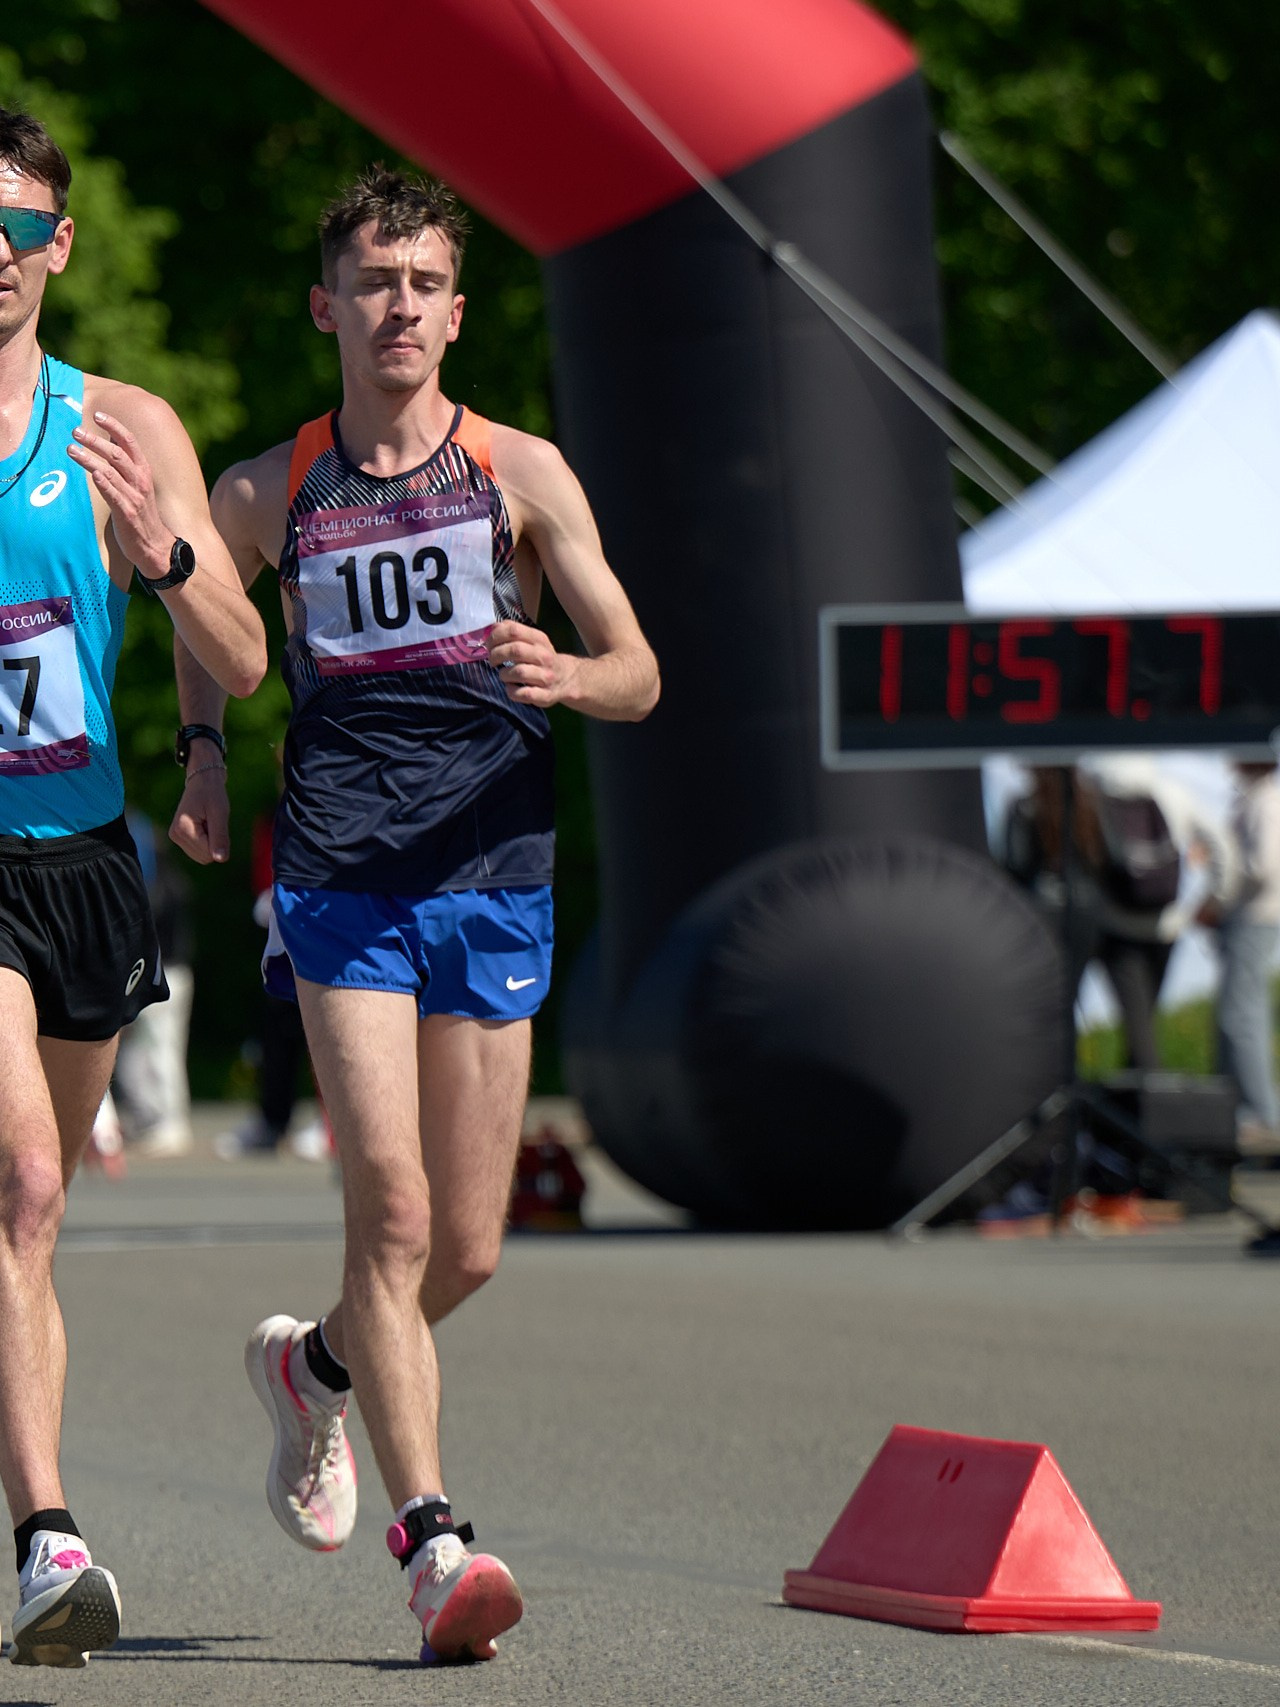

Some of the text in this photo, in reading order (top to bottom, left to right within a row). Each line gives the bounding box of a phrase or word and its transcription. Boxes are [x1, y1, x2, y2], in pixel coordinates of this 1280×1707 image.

[304, 504, 468, 535] ЧЕМПИОНАТ РОССИИ
[318, 529, 357, 541] ходьбе
[336, 546, 454, 634] 103
